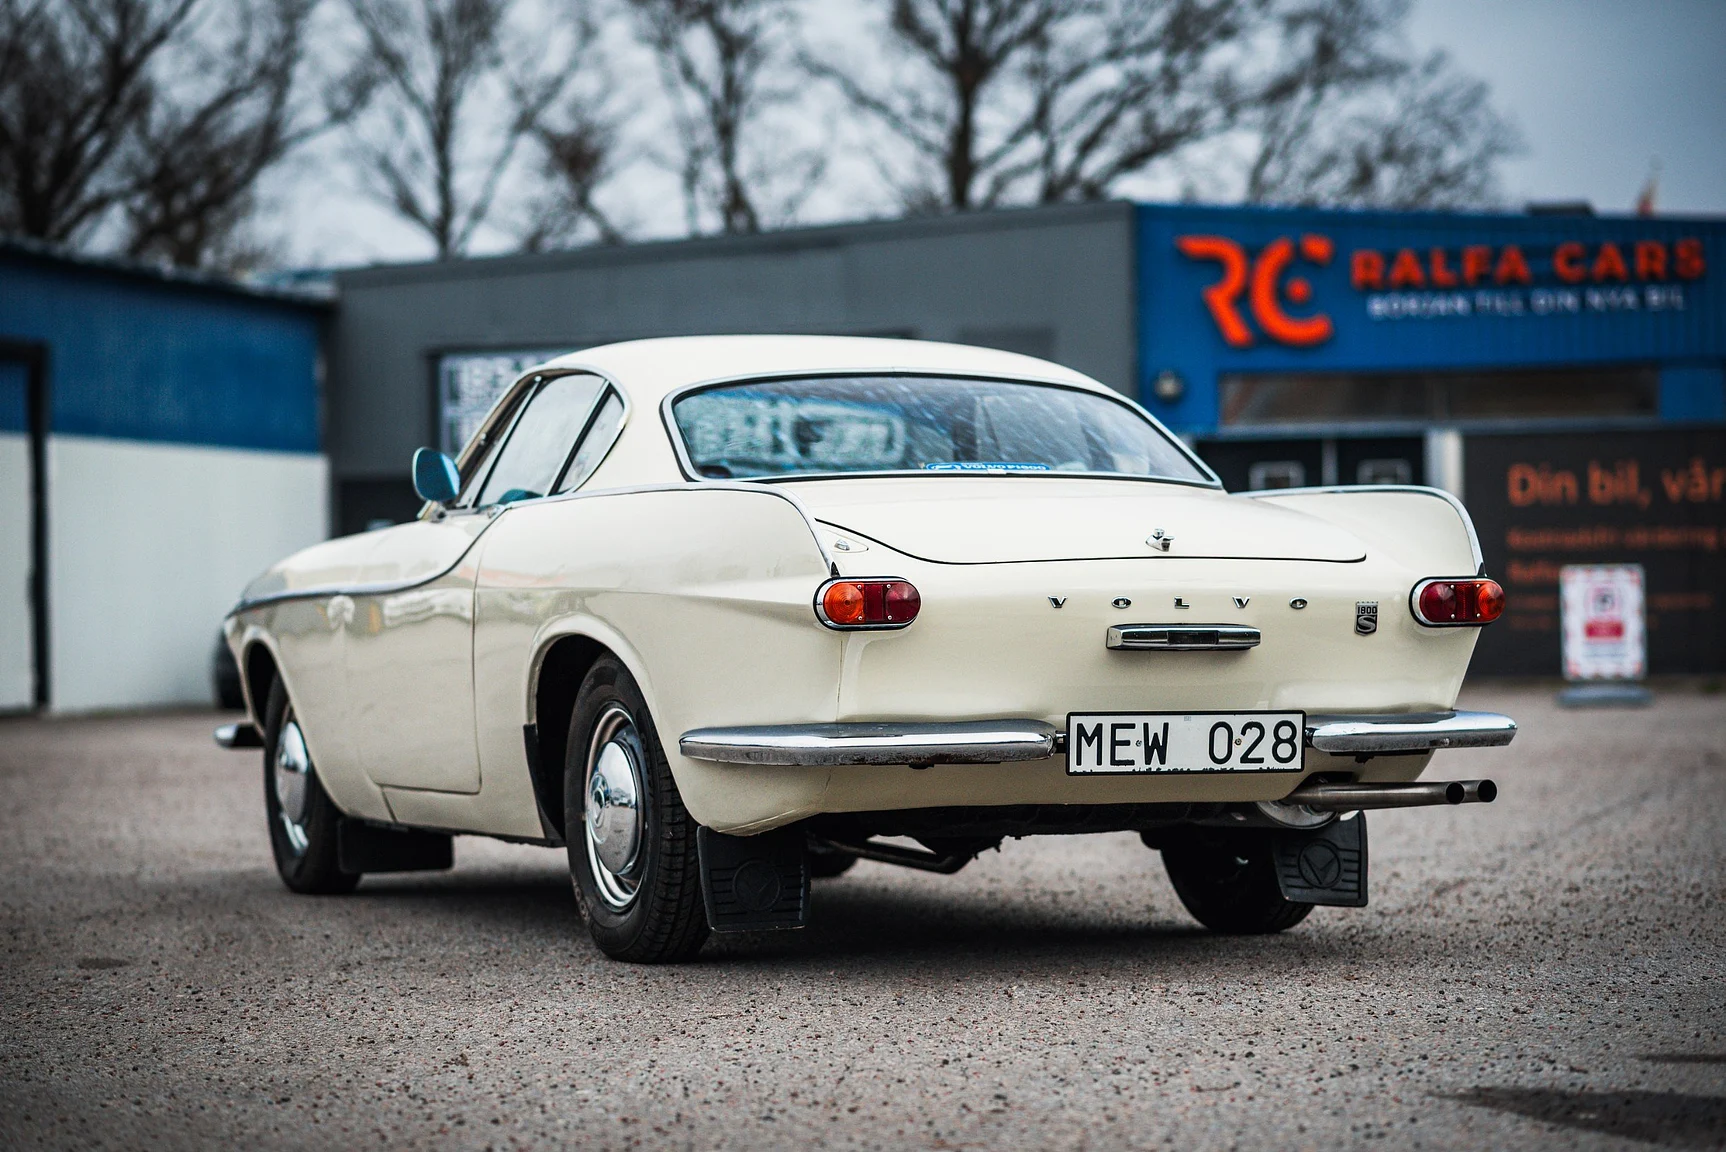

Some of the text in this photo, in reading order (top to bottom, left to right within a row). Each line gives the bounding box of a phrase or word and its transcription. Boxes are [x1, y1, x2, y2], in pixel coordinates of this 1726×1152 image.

[1350, 238, 1706, 290] RALFA CARS
[1507, 463, 1579, 506] Din
[1588, 460, 1651, 510] bil,
[1048, 595, 1308, 610] VOLVO
[1357, 606, 1377, 615] 1800
[1075, 720, 1298, 766] MEW 028
